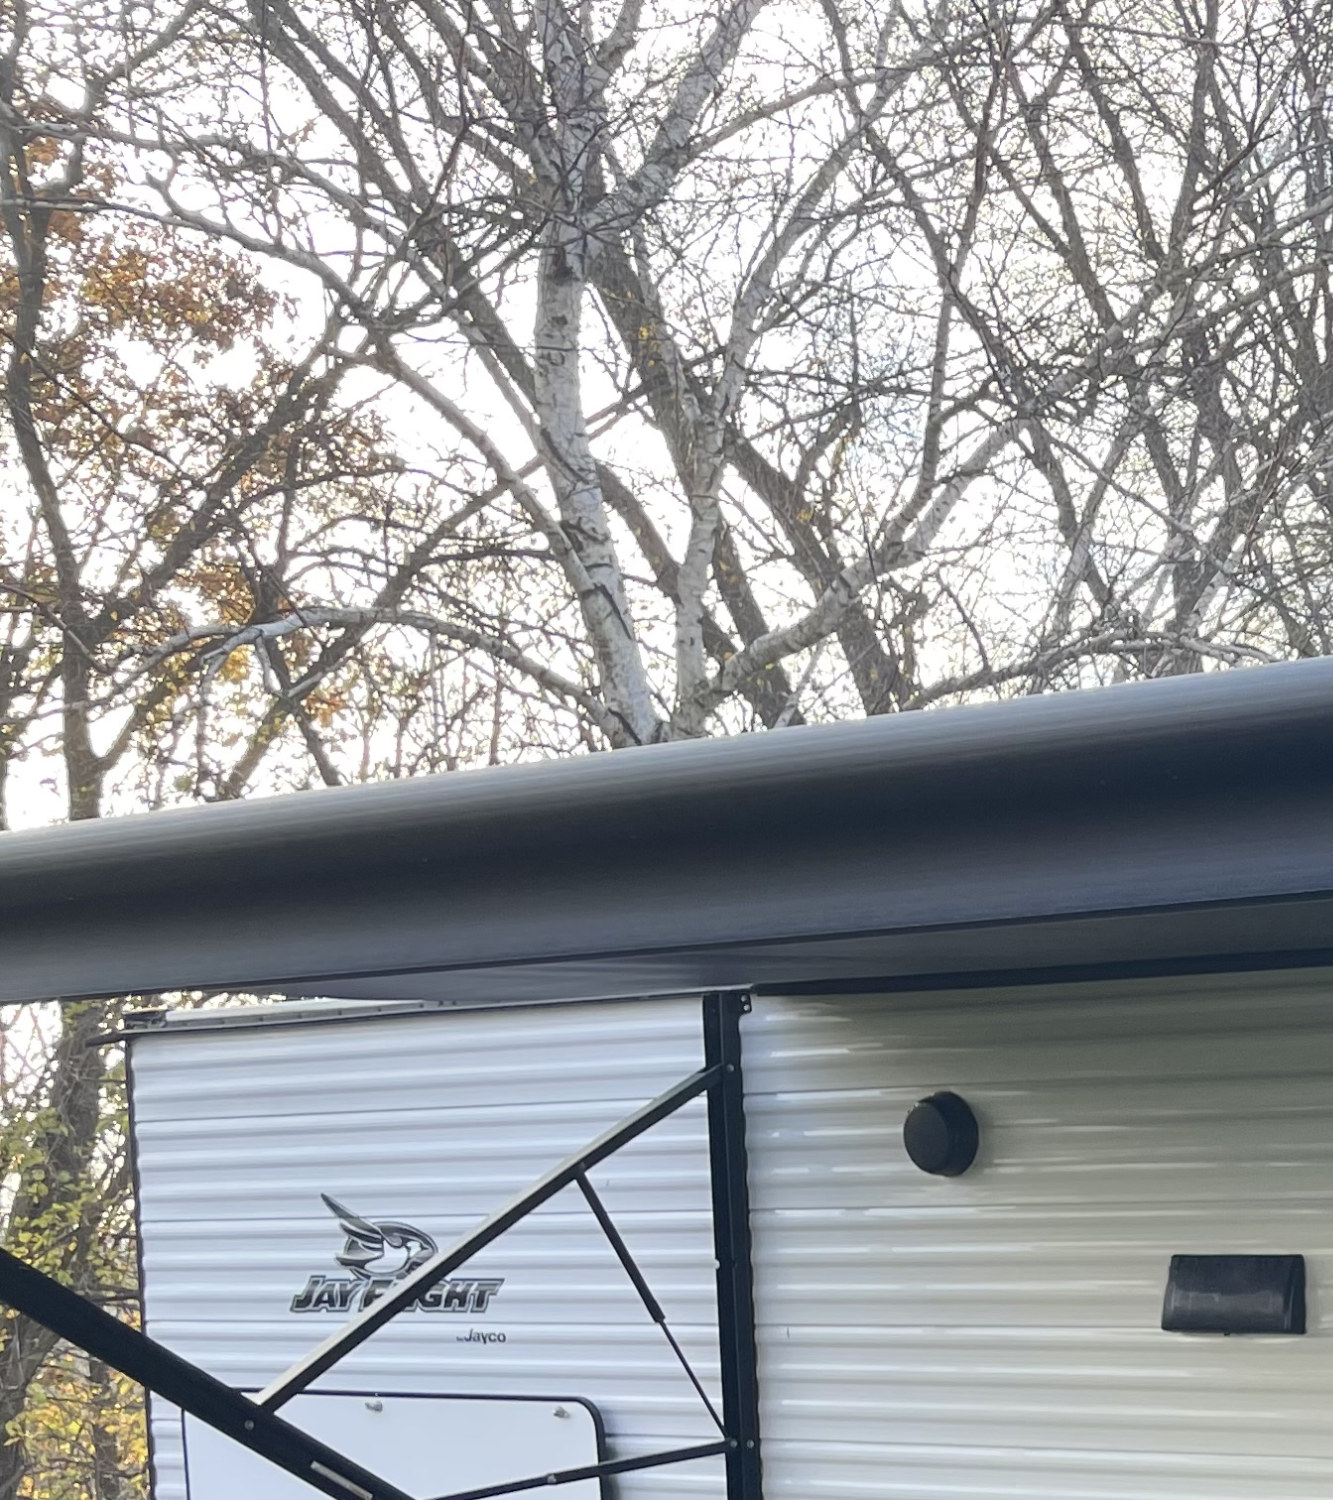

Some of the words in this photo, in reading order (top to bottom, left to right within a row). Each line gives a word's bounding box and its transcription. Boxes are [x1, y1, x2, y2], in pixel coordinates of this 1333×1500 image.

[290, 1275, 366, 1312] JAY
[358, 1278, 504, 1313] FGHT
[464, 1328, 507, 1345] Jayco
